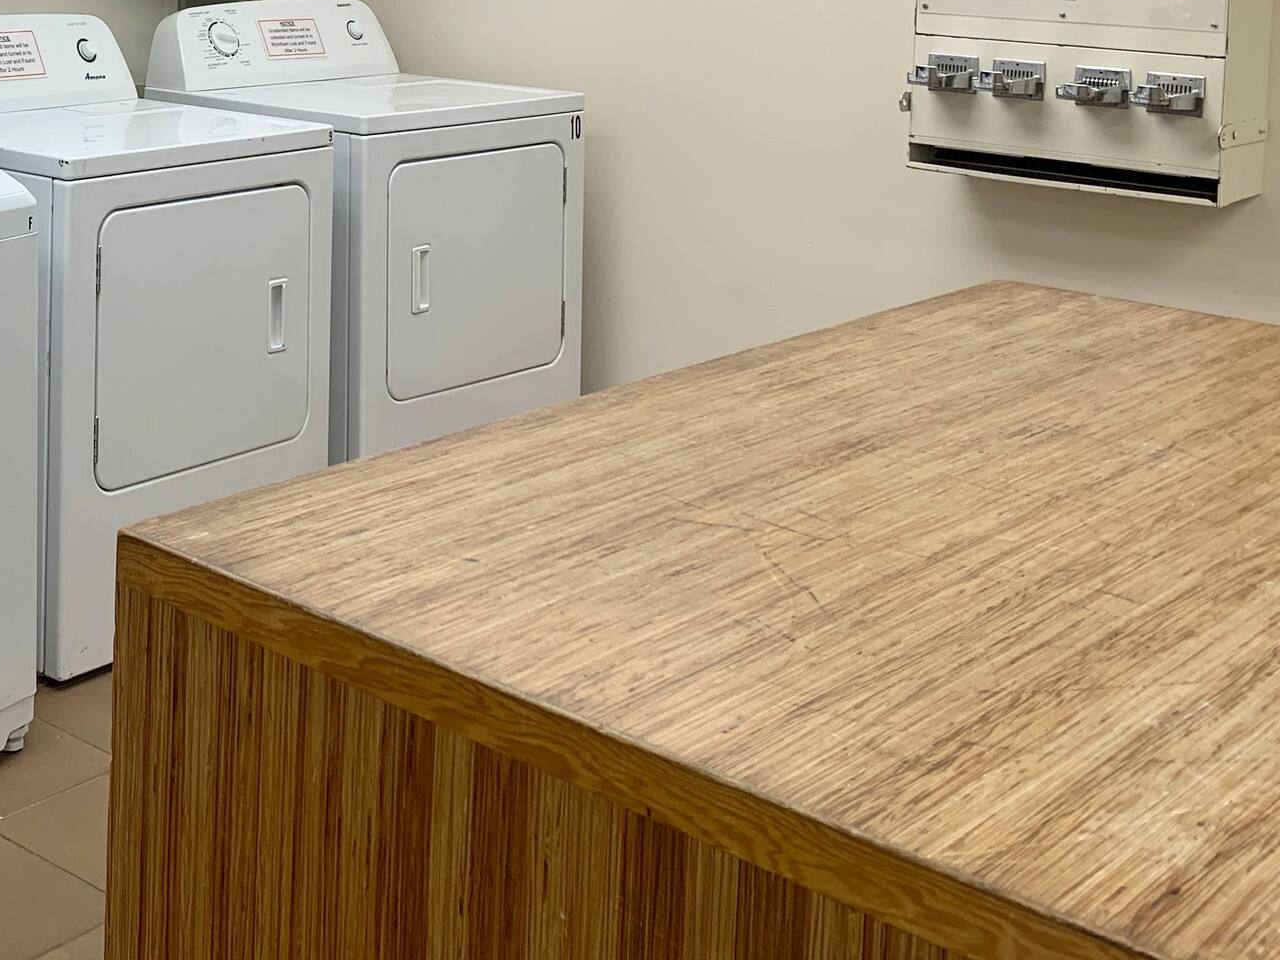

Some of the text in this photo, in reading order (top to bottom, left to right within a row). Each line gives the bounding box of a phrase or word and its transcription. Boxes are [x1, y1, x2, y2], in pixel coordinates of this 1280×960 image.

[571, 115, 581, 140] 10
[329, 130, 332, 142] 9
[29, 217, 32, 230] F
